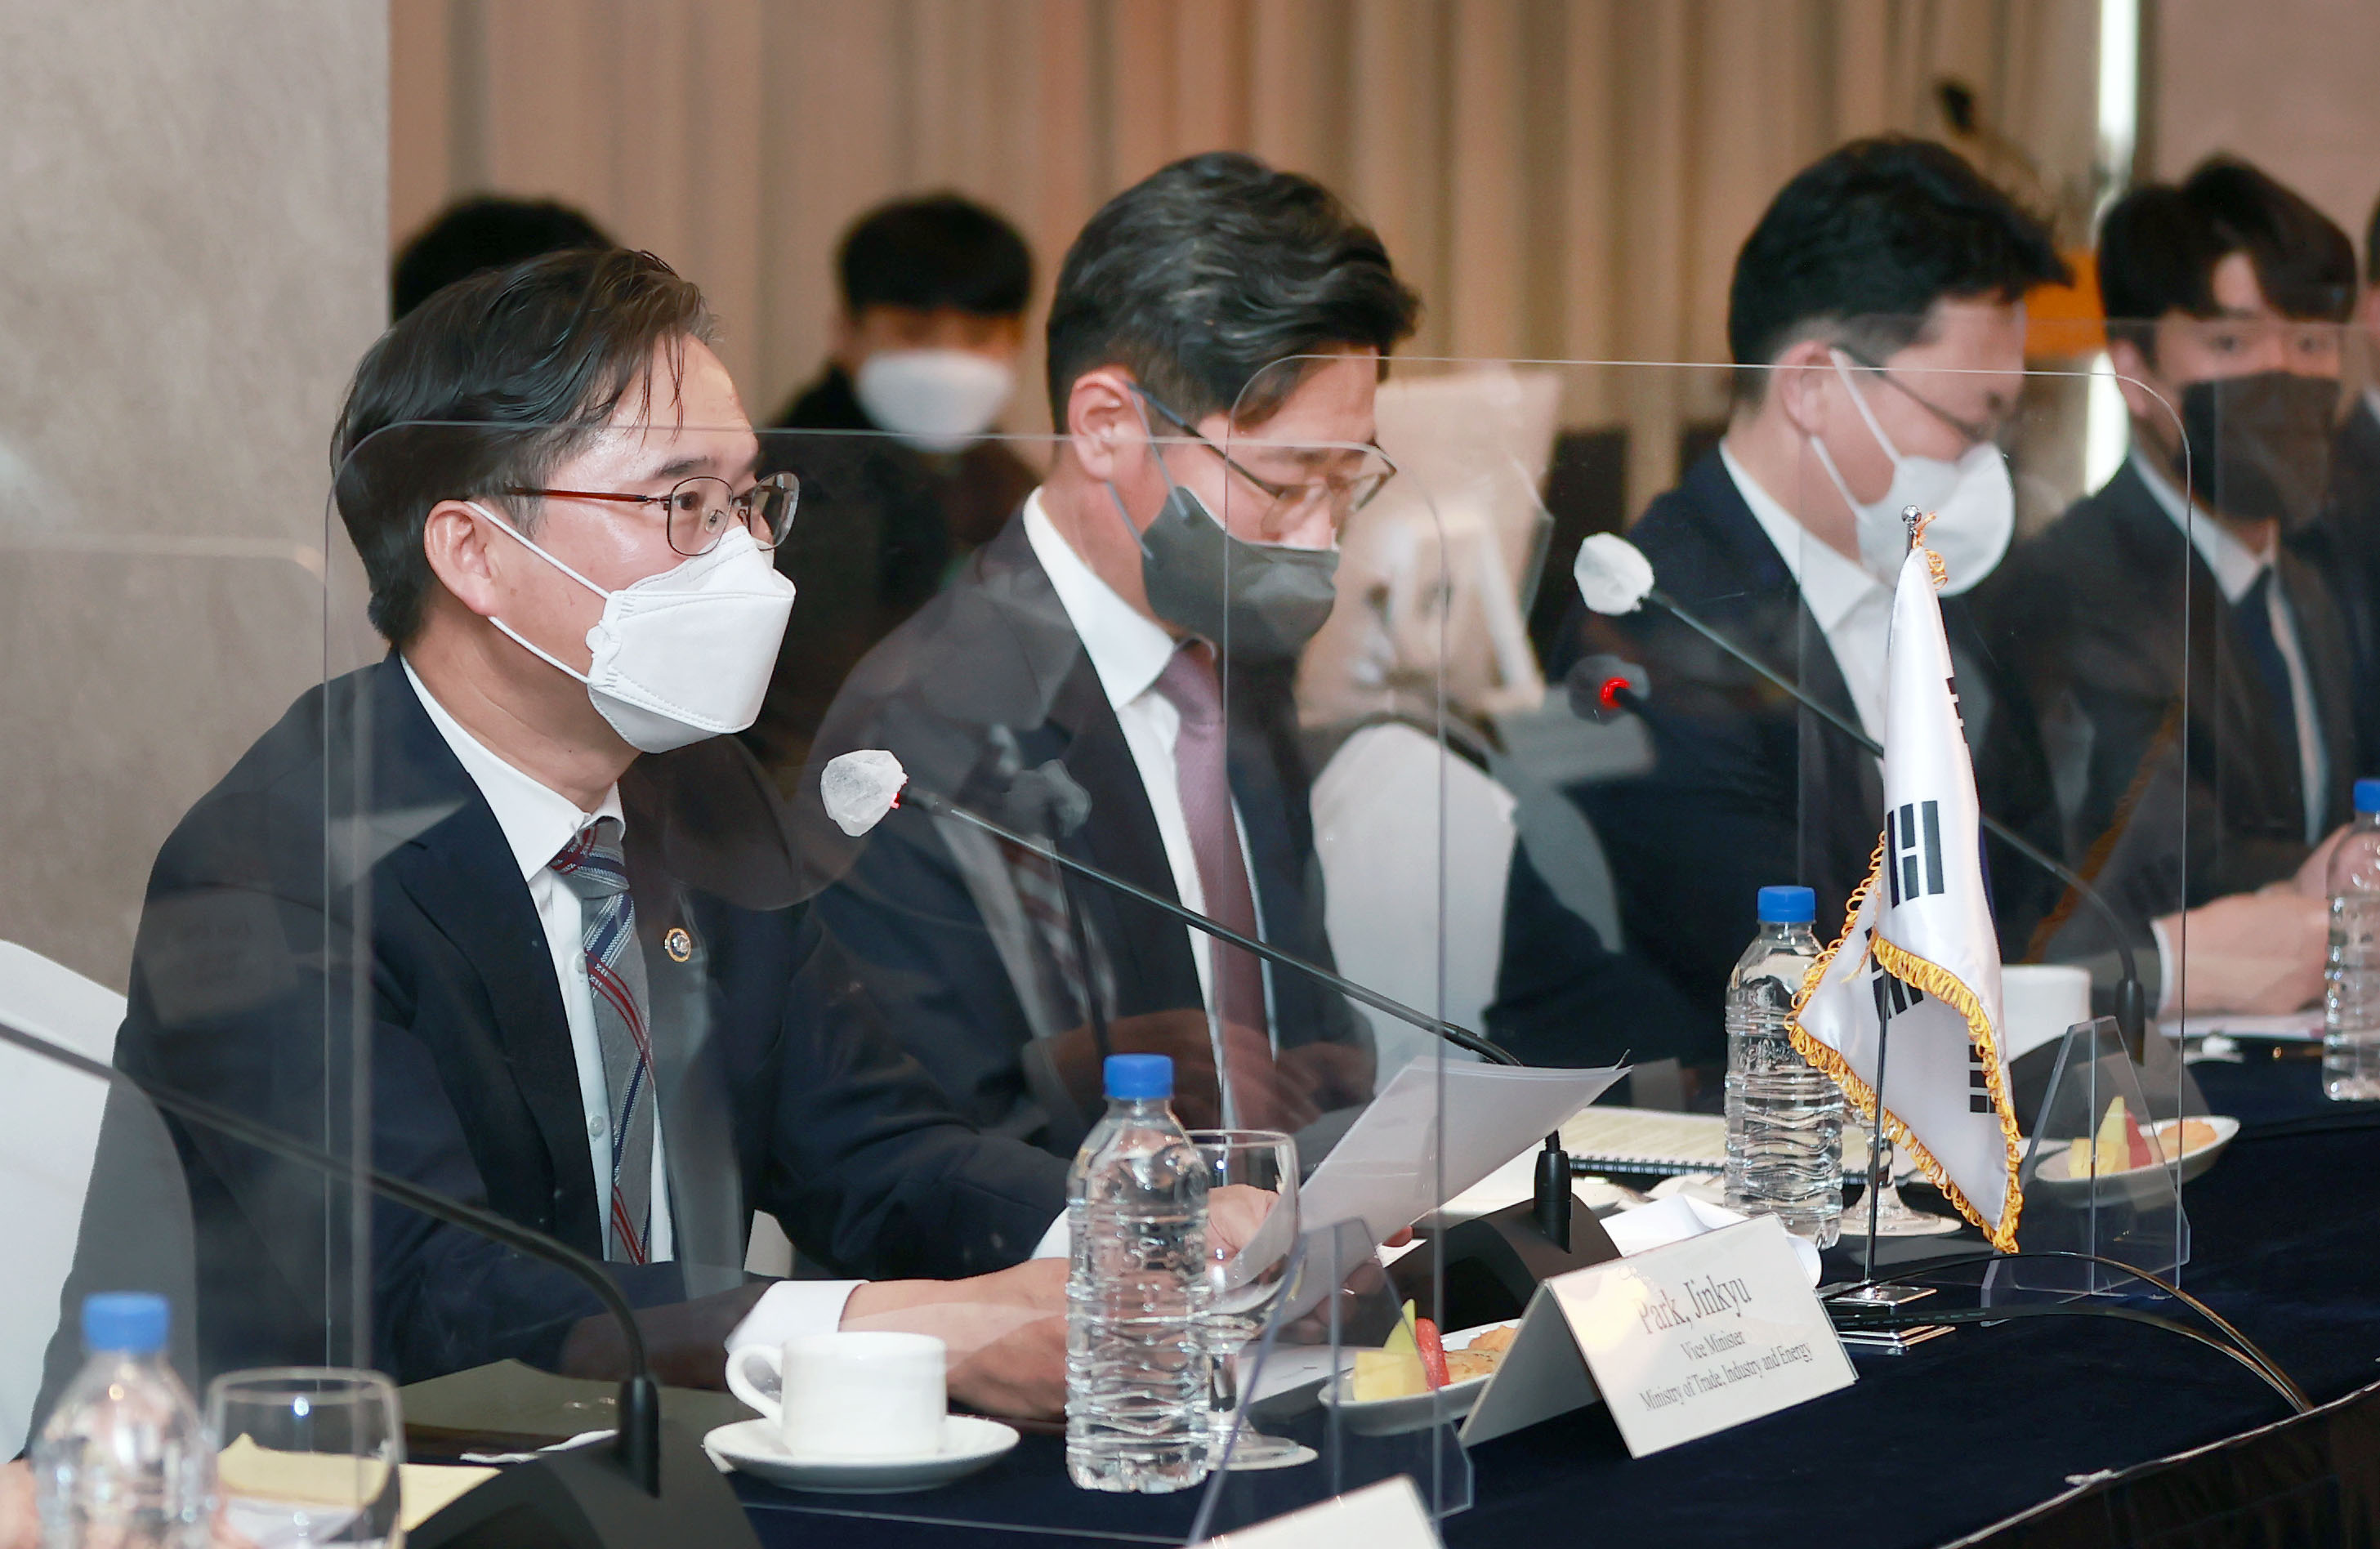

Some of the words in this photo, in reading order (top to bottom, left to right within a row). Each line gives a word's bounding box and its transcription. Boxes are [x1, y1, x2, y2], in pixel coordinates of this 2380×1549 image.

[1634, 1289, 1693, 1334] Park,
[1683, 1274, 1752, 1318] Jinkyu
[1681, 1341, 1708, 1360] Vice
[1704, 1330, 1745, 1355] Minister
[1639, 1386, 1684, 1411] Ministry
[1683, 1376, 1696, 1397] of
[1691, 1368, 1726, 1393] Trade,
[1721, 1360, 1763, 1383] Industry
[1762, 1348, 1780, 1370] and
[1777, 1342, 1813, 1364] Energy
